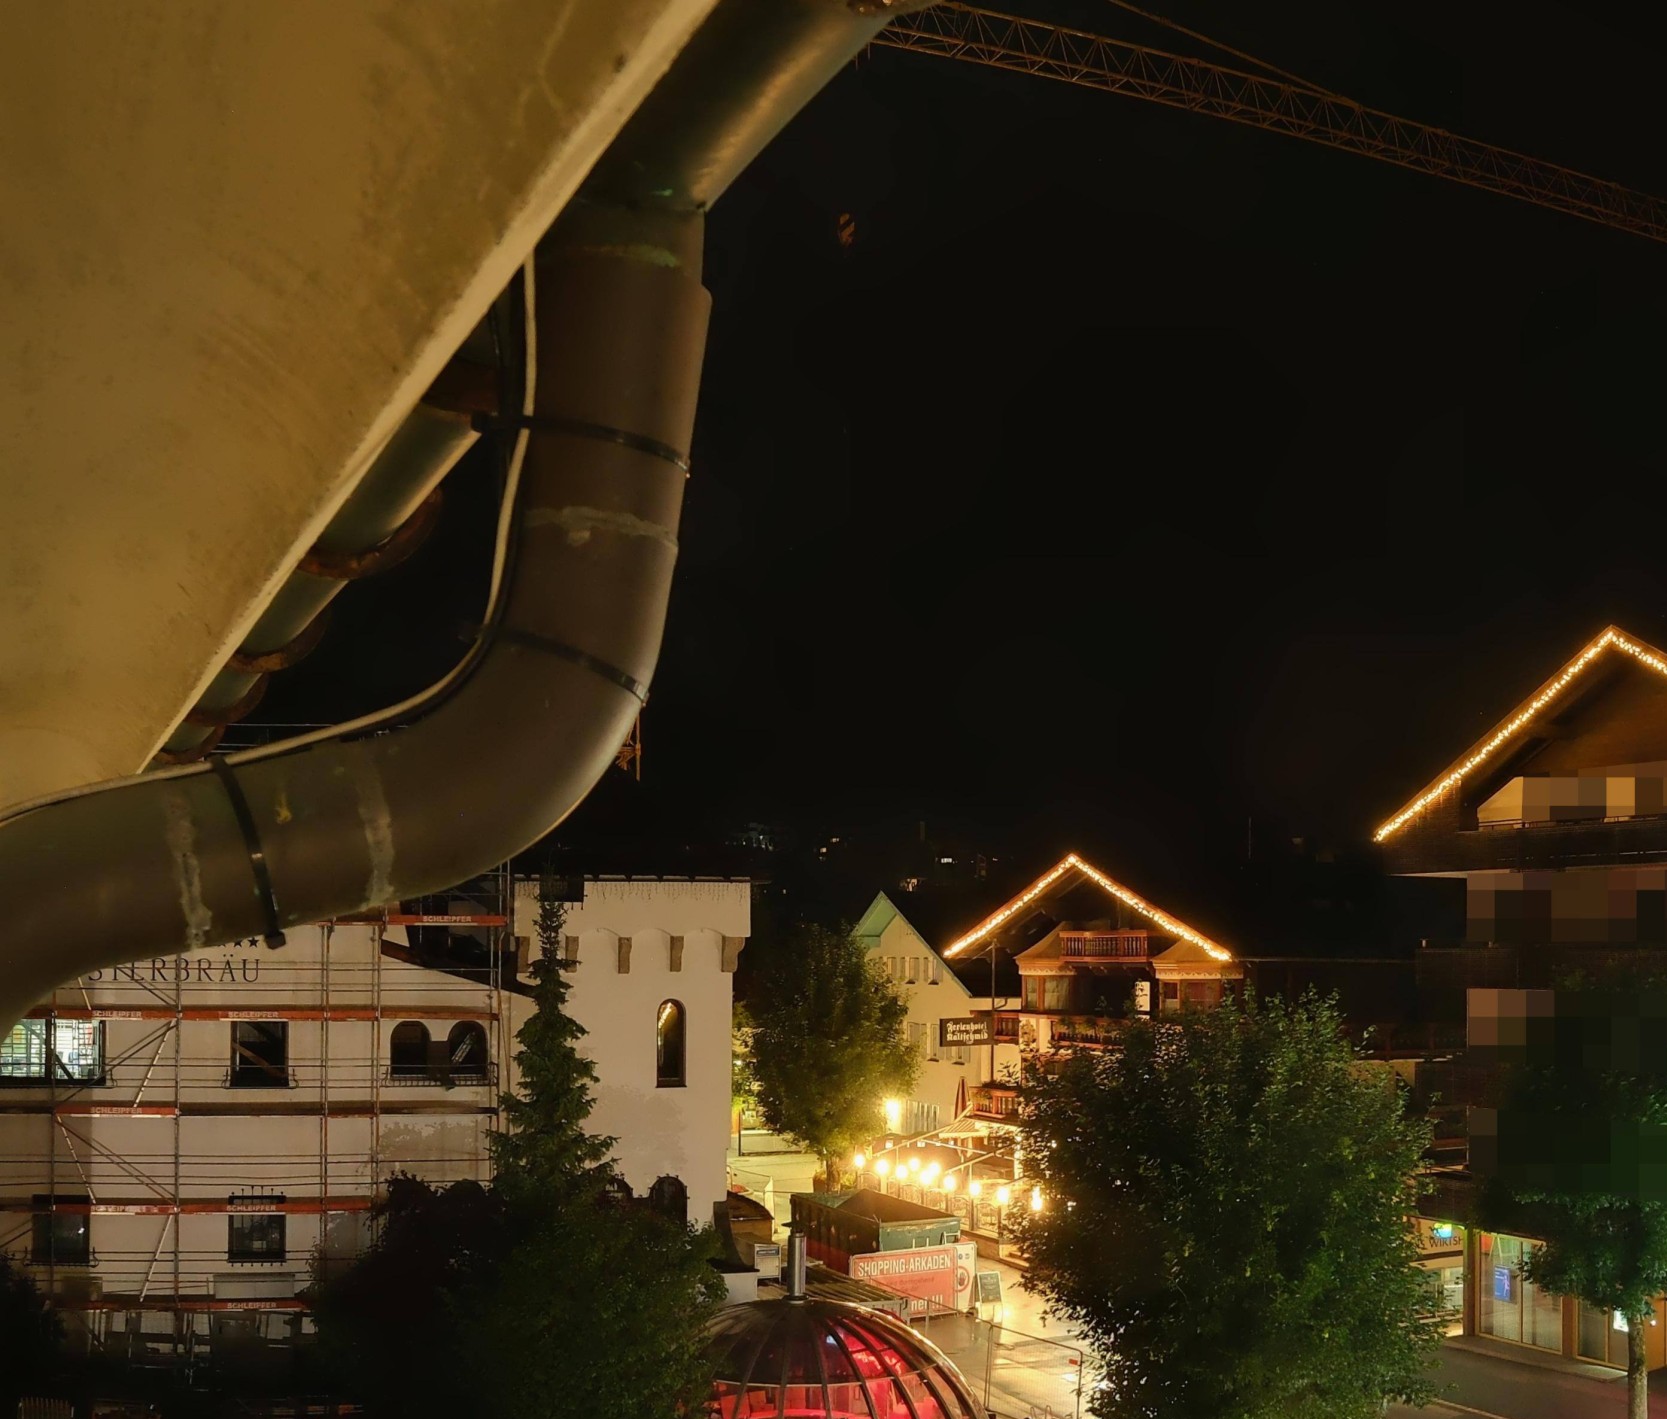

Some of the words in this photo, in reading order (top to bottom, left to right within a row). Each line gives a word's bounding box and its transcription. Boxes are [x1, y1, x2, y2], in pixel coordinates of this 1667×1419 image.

[92, 1010, 142, 1018] SCHLEIPFER
[91, 1106, 142, 1114] SCHLEIPFER
[226, 1204, 276, 1212] SCHLEIPFER
[858, 1254, 951, 1277] SHOPPING-ARKADEN
[227, 1301, 277, 1309] SCHLEIPFER
